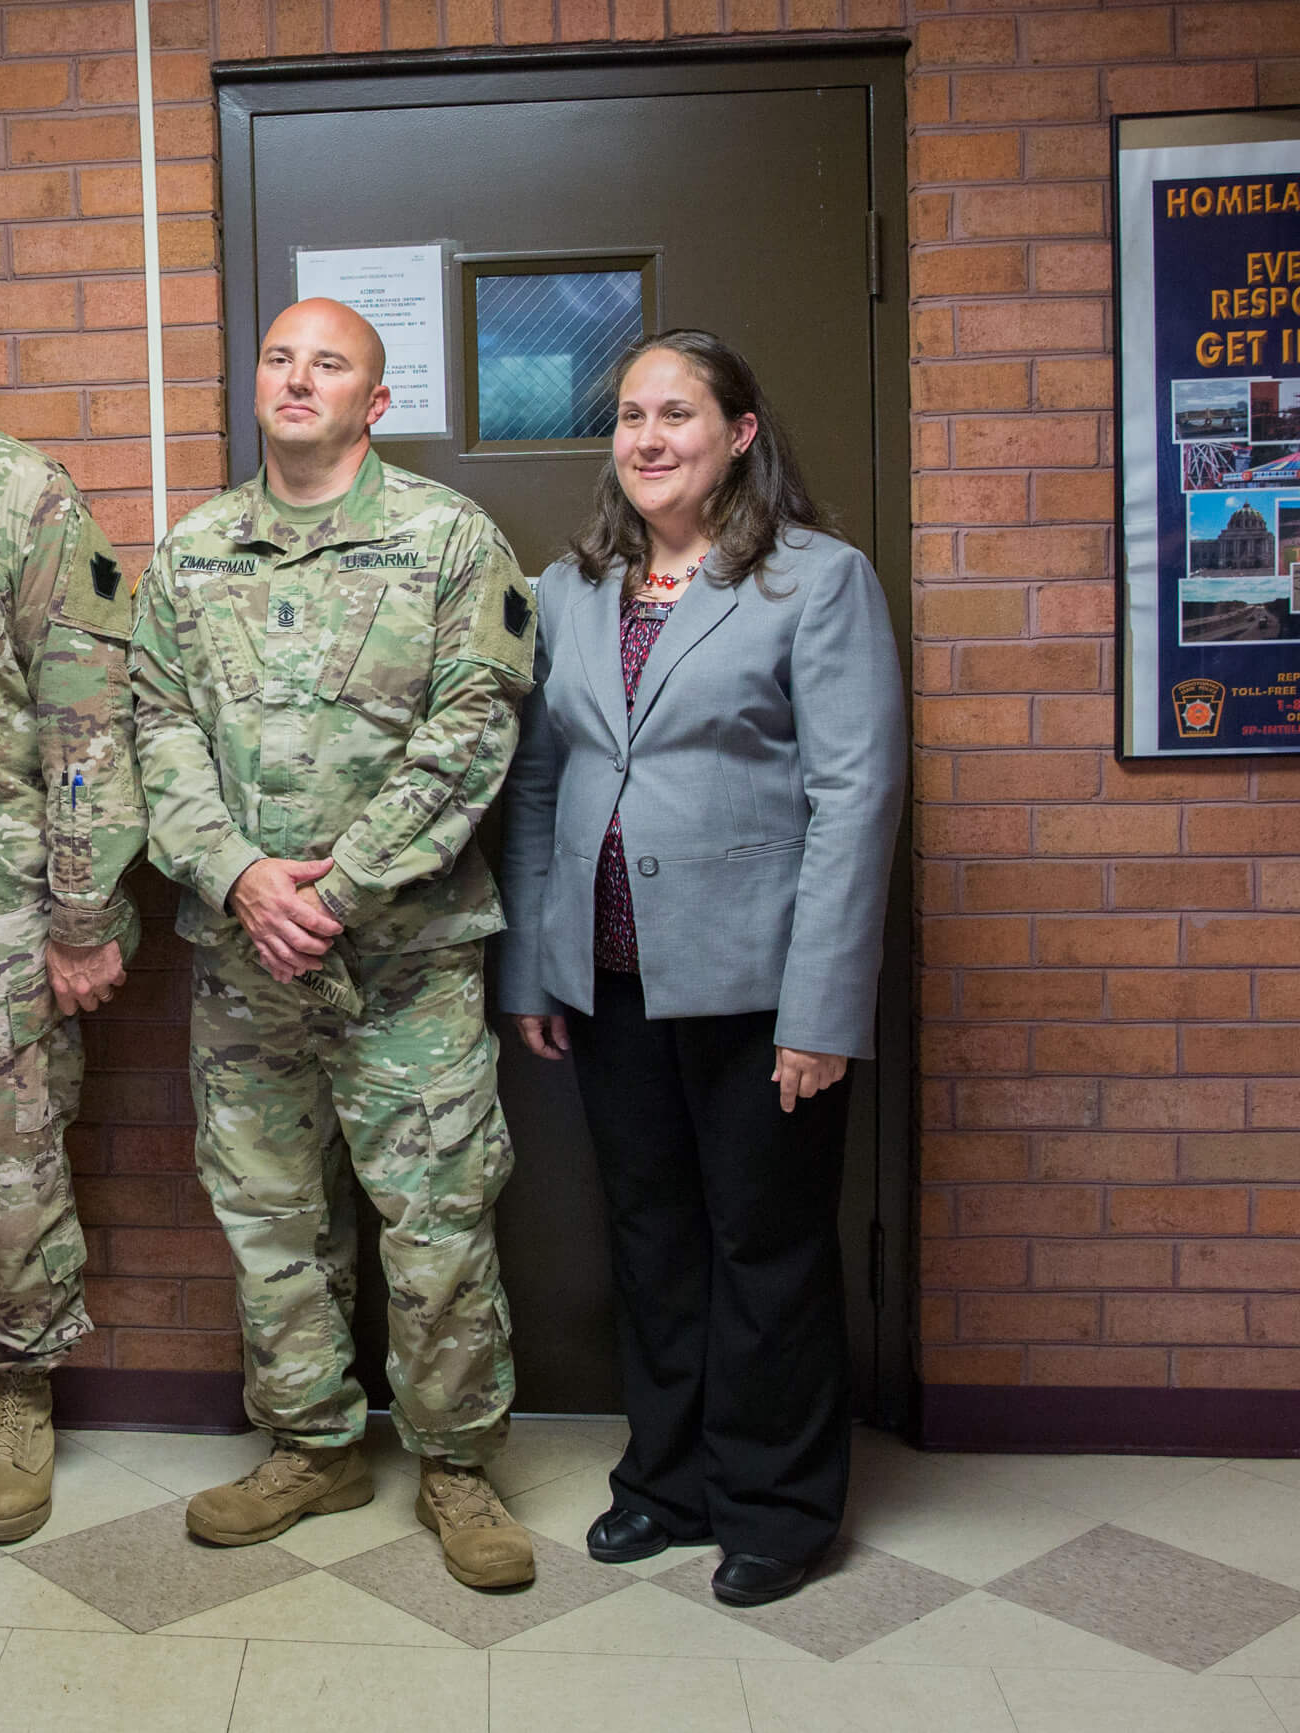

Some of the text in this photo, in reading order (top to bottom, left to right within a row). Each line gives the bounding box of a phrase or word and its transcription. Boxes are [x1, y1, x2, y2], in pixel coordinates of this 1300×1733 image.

[1196, 329, 1300, 368] GET I
[179, 556, 256, 573] ZIMMERMAN
[1231, 686, 1297, 696] TOLL-FREE
[1287, 713, 1300, 721] O
